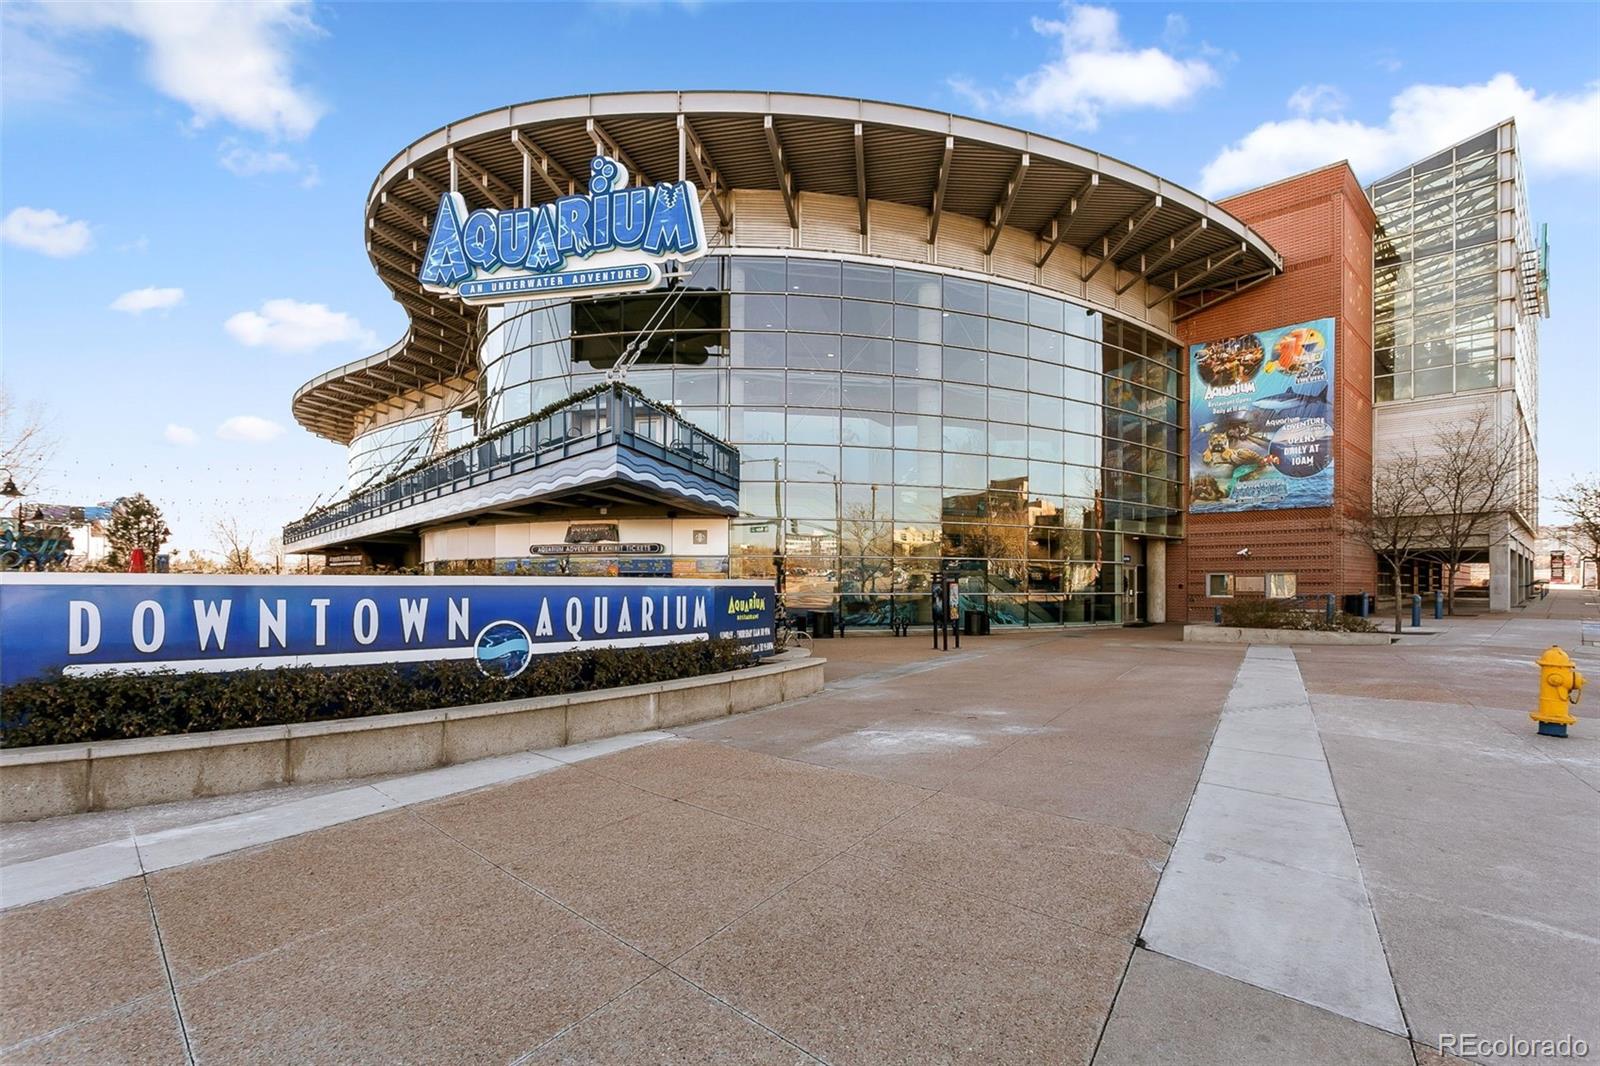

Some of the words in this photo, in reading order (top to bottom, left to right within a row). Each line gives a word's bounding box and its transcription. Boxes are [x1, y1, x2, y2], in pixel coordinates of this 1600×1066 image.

[421, 155, 695, 284] AQUARIUM
[469, 284, 483, 293] AN
[491, 276, 563, 291] UNDERWATER
[572, 268, 640, 284] ADVENTURE
[1309, 445, 1320, 453] AT
[1291, 456, 1314, 466] 10AM
[728, 592, 766, 614] AQUARIUM
[68, 597, 470, 655] DOWNTOWN
[535, 595, 707, 641] AQUARIUM
